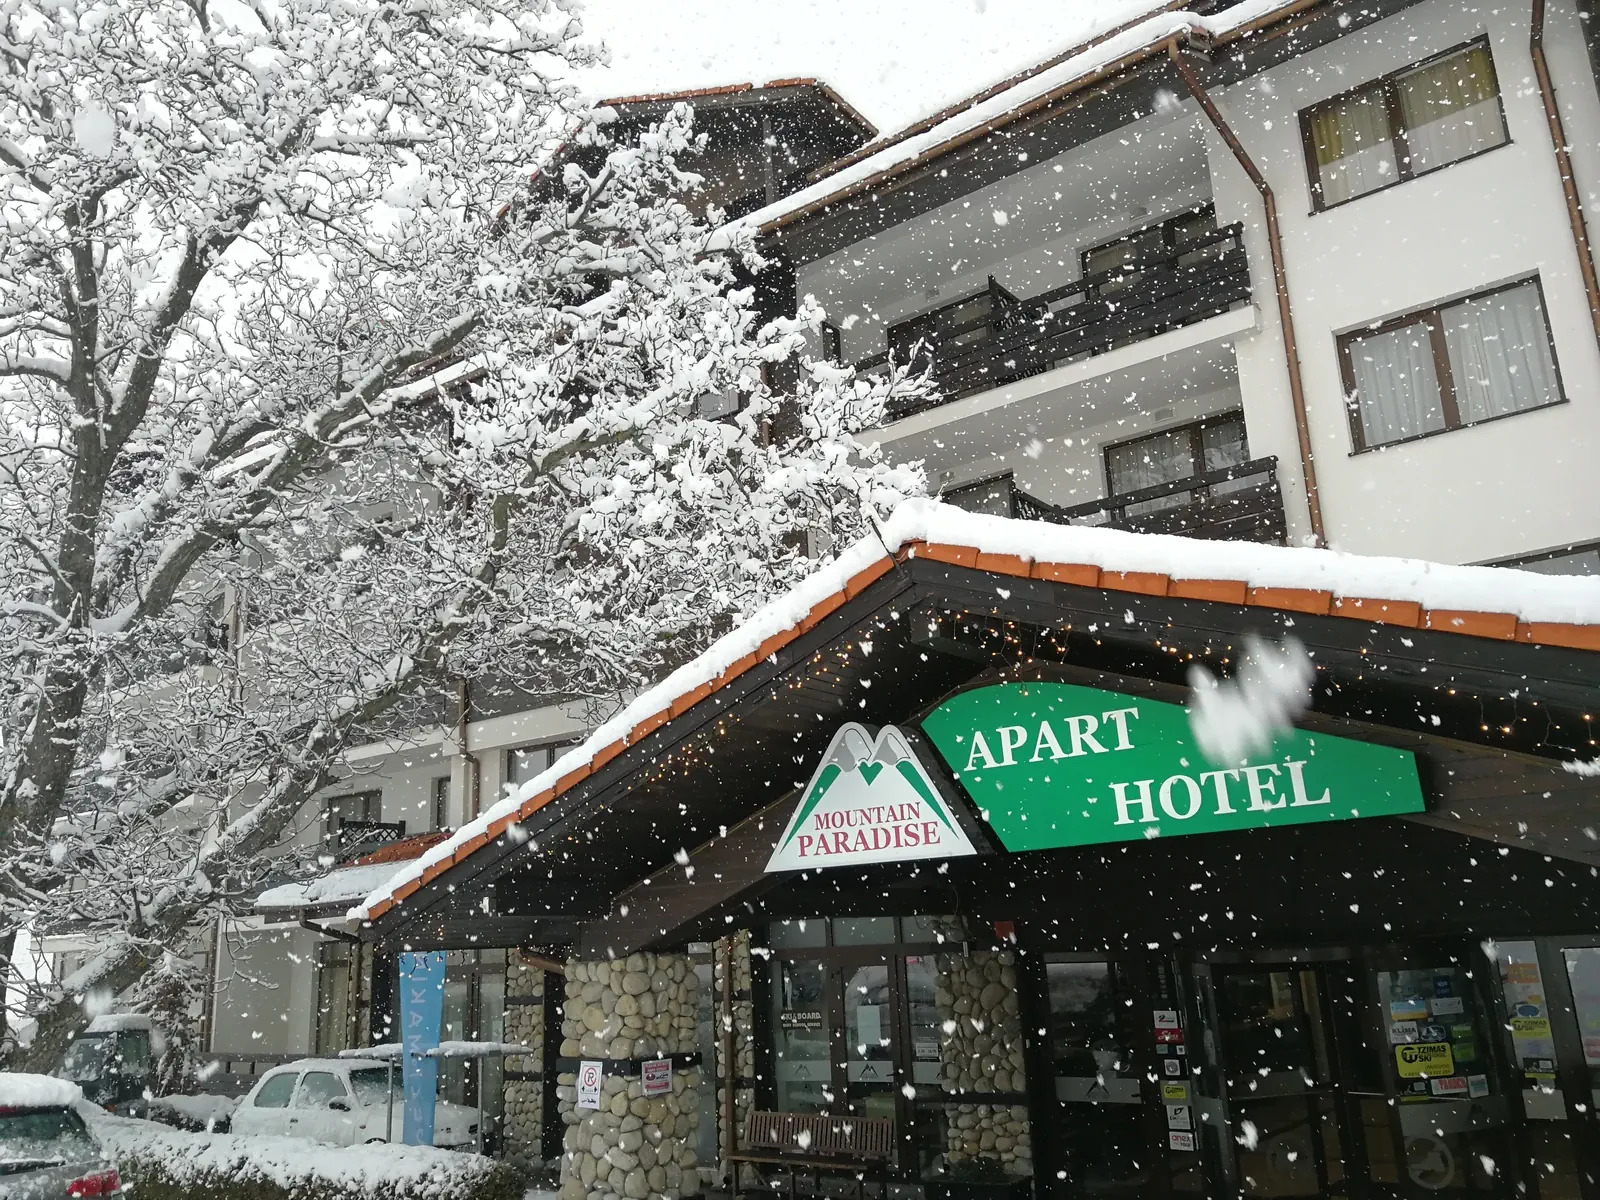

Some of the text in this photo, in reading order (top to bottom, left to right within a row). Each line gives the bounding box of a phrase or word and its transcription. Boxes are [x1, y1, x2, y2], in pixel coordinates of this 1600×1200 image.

[964, 708, 1139, 772] APART
[814, 801, 921, 831] MOUNTAIN
[1109, 760, 1331, 826] HOTEL
[797, 821, 941, 857] PARADISE
